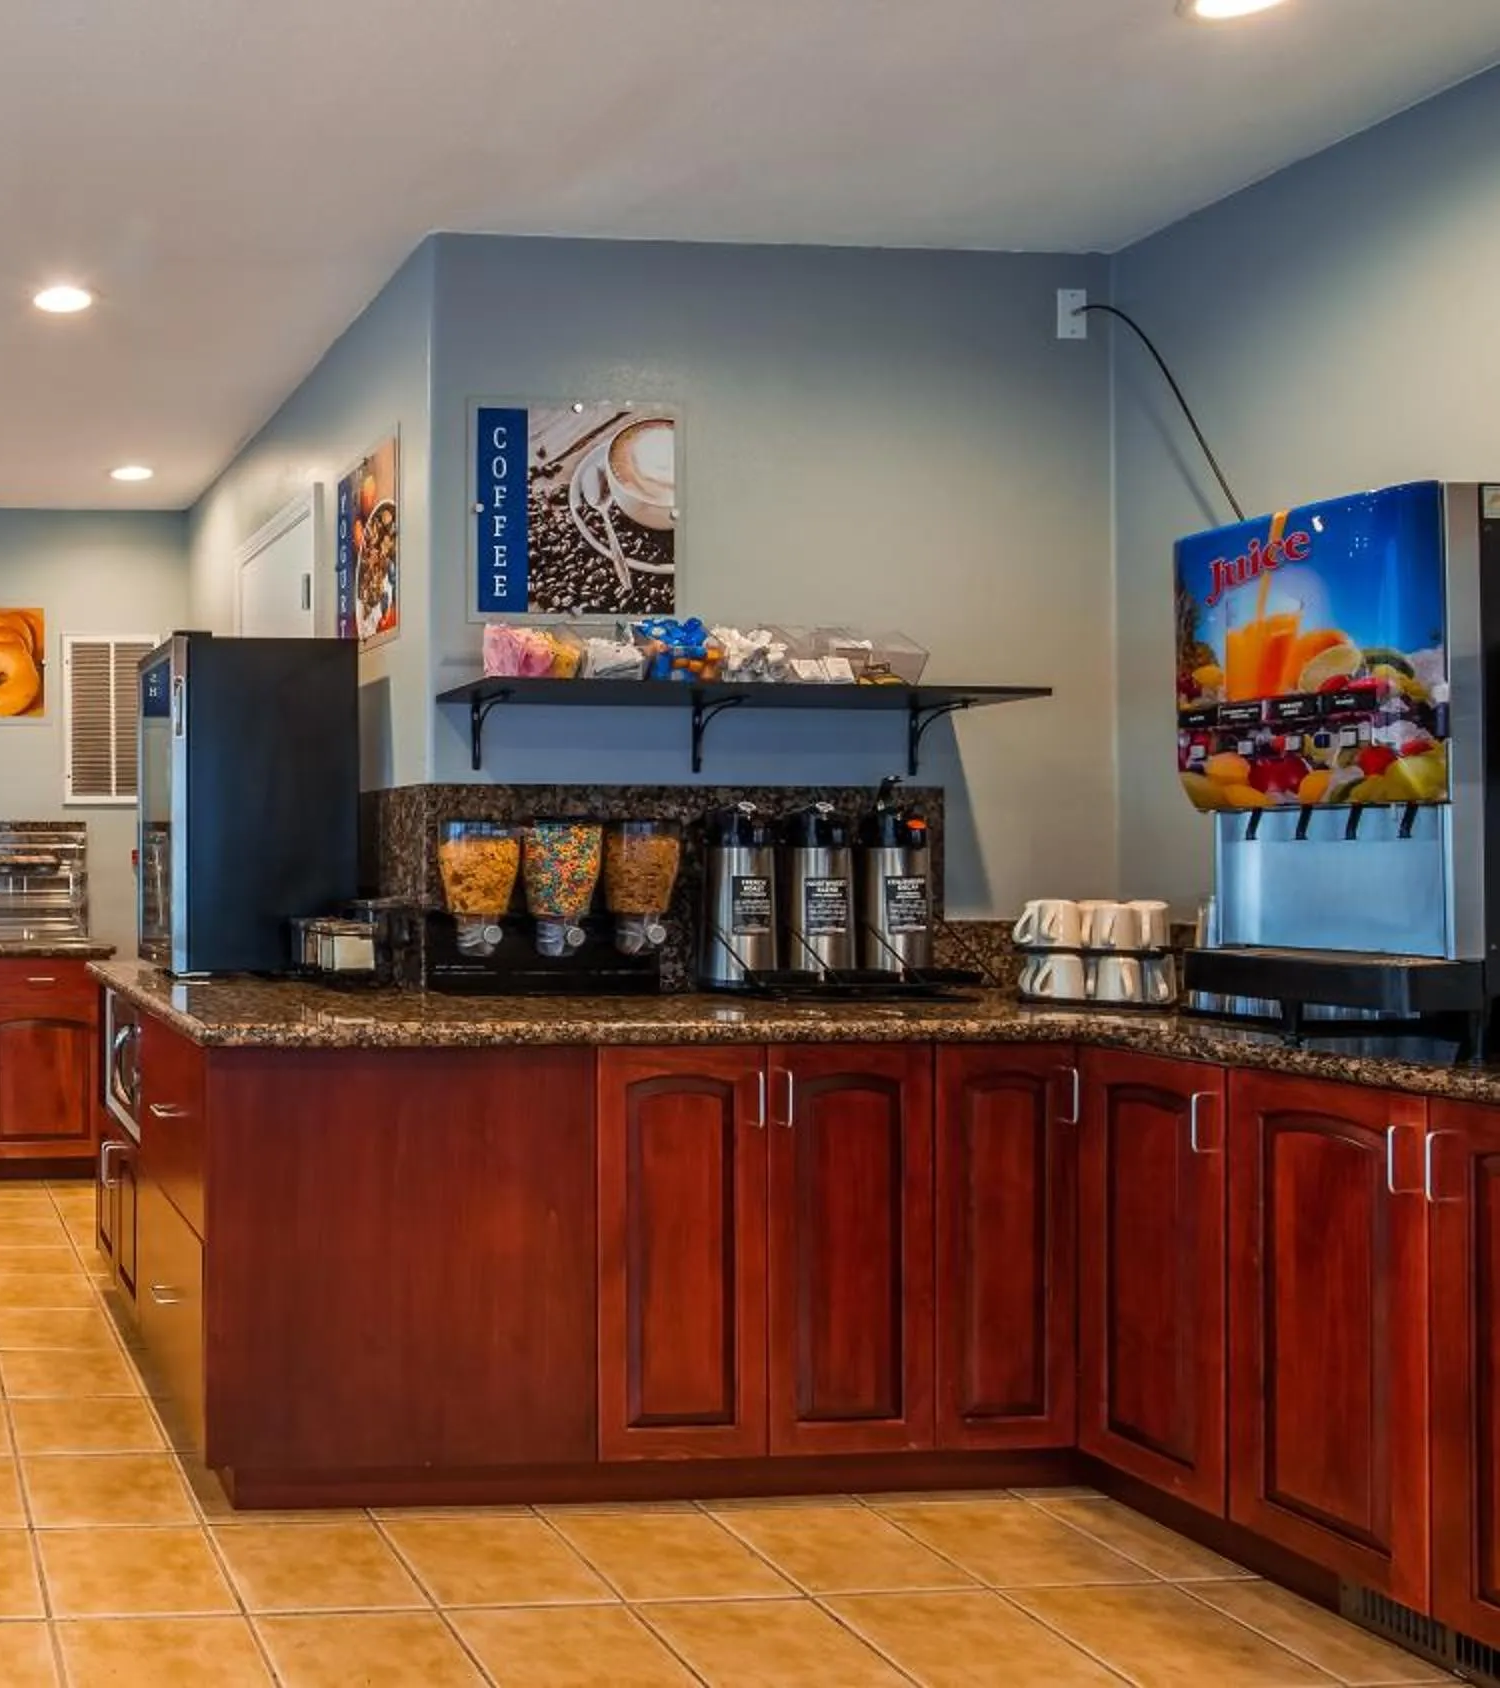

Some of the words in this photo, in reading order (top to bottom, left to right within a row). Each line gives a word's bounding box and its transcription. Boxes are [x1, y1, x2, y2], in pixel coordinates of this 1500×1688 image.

[338, 493, 347, 639] YOGURT
[492, 426, 508, 597] COFFEE
[1204, 530, 1312, 608] Juice
